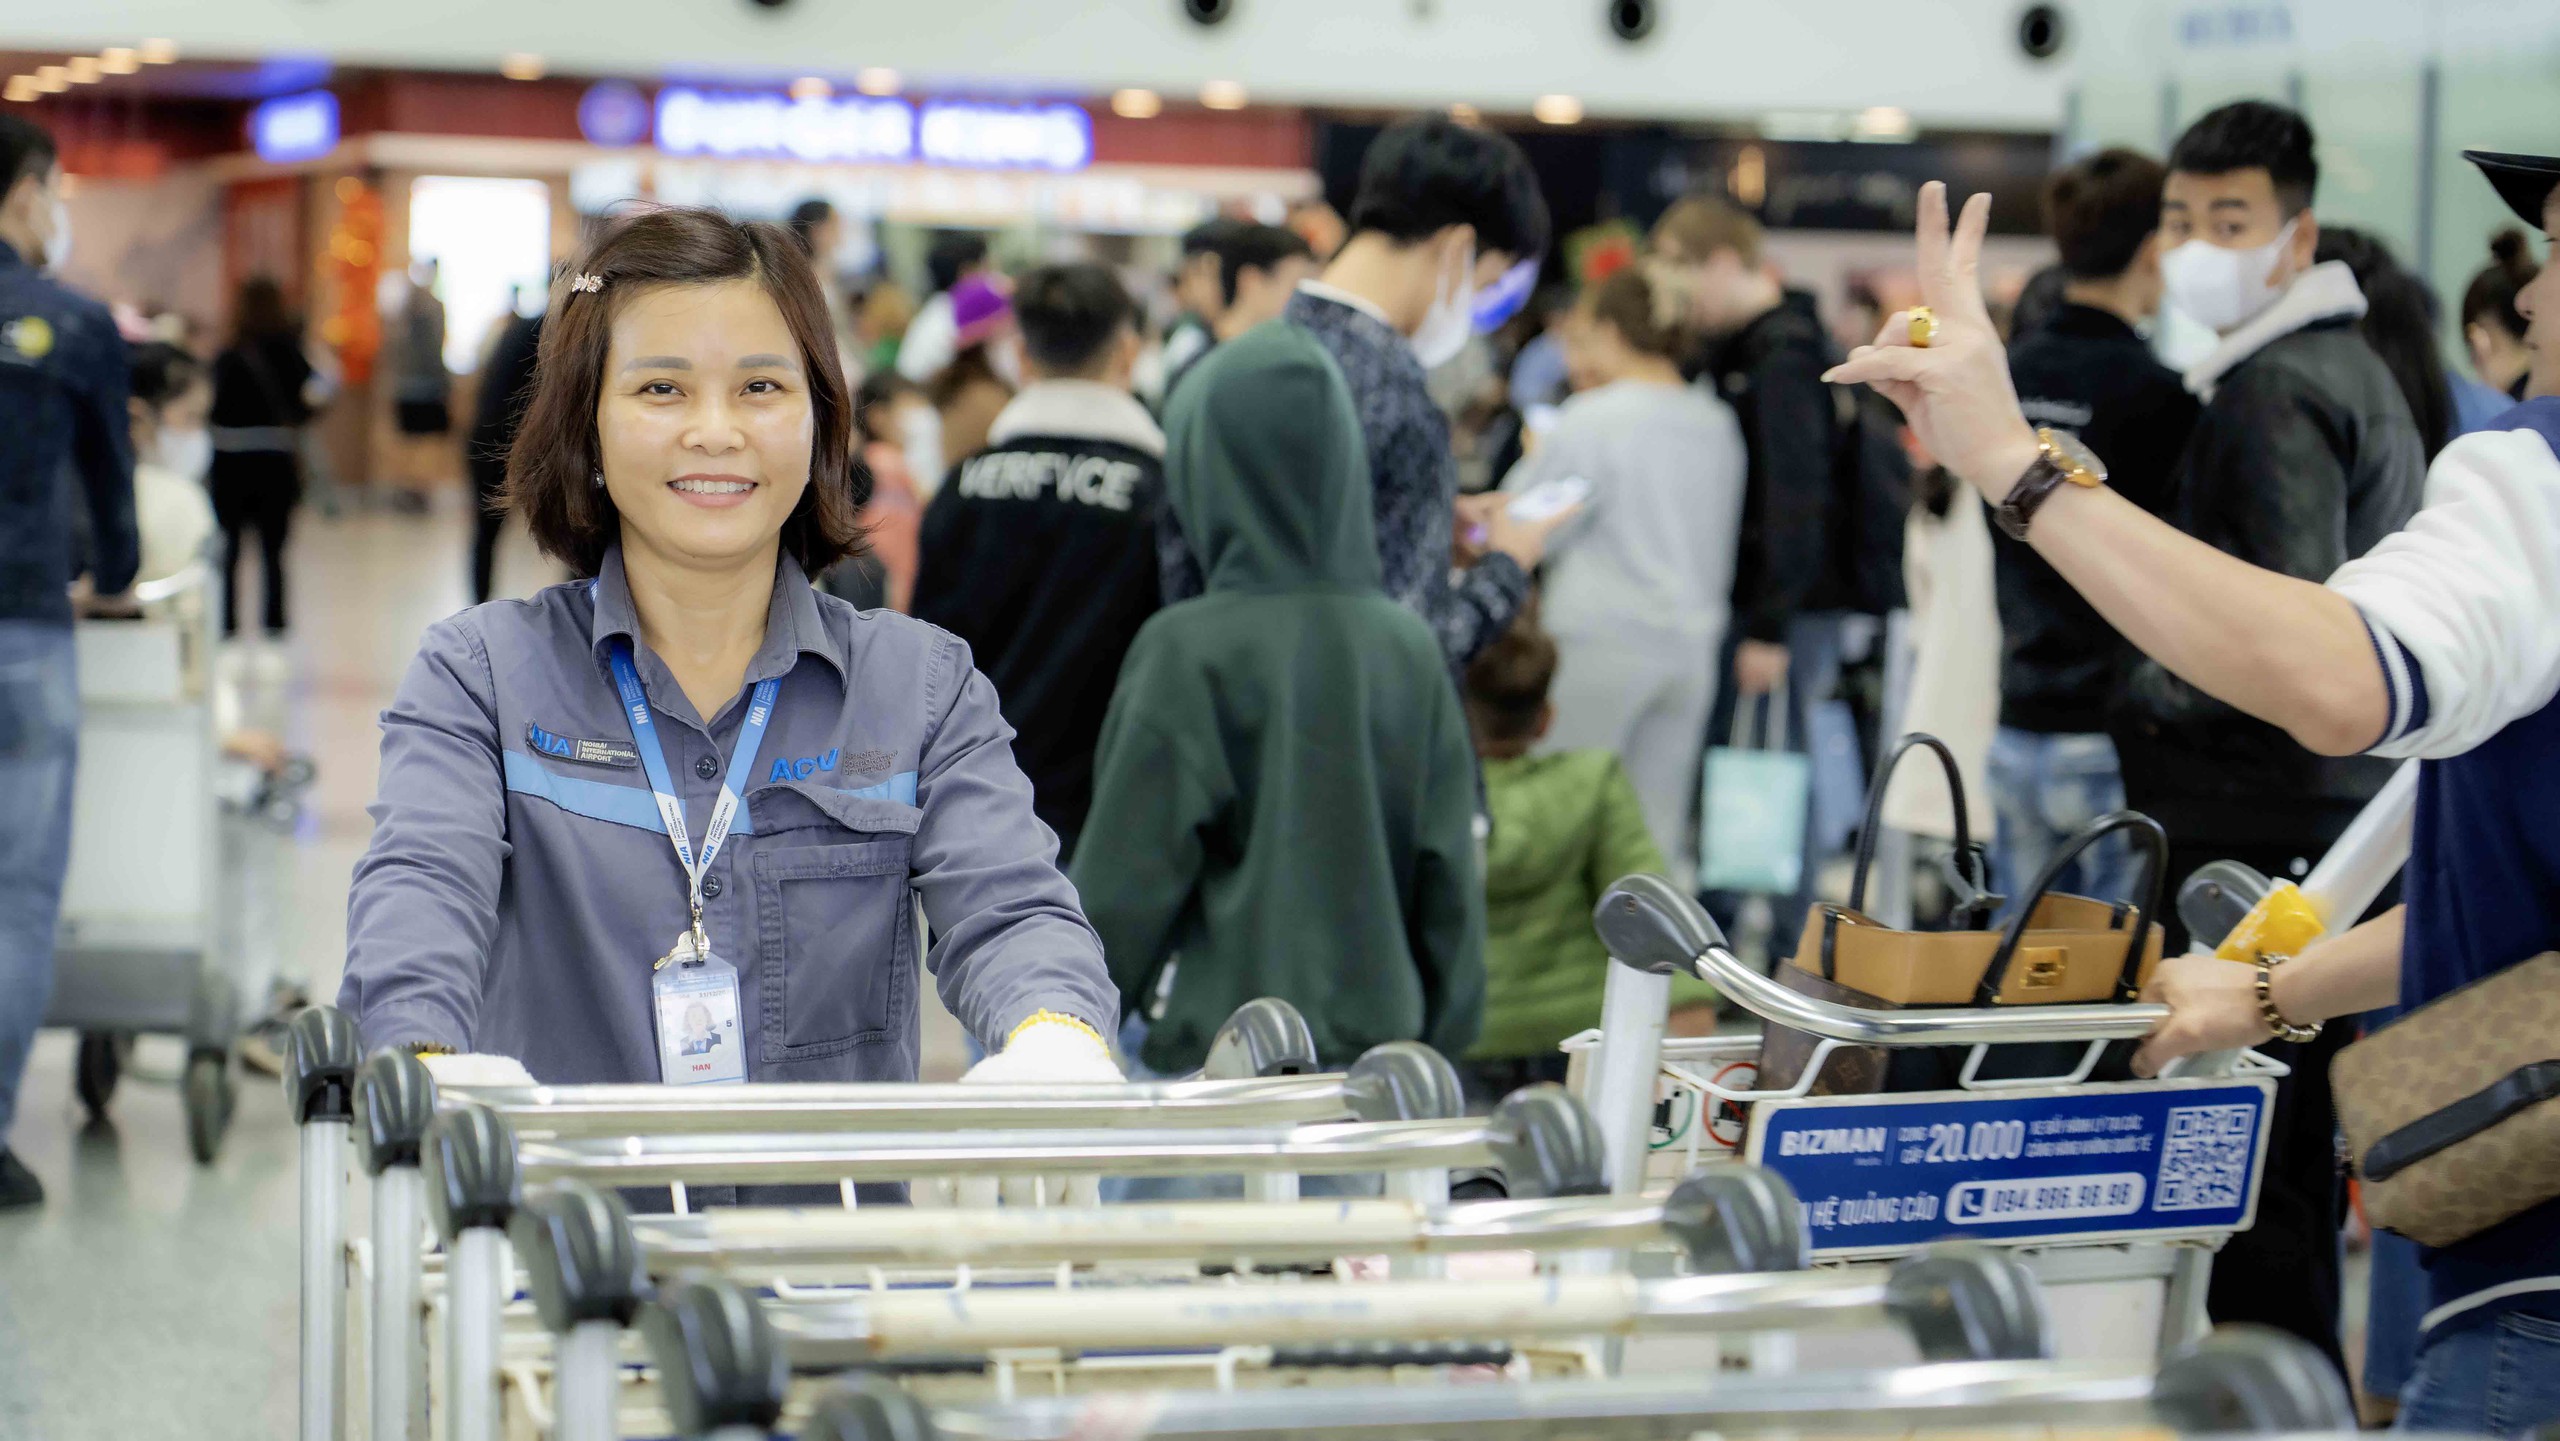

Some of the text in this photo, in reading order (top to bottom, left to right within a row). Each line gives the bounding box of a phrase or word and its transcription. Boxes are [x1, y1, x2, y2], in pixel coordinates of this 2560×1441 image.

[632, 703, 649, 725] NIA
[750, 706, 767, 726] NIA
[531, 722, 572, 757] NIA
[580, 754, 612, 762] AIRPORT
[581, 747, 636, 758] INTERNATIONAL
[769, 747, 839, 783] ACV
[712, 801, 730, 839] INTERNATIONAL
[717, 819, 728, 840] AIRPORT
[680, 845, 692, 865] NIA
[702, 844, 715, 865] NIA
[692, 1063, 711, 1072] HAN
[1779, 1126, 1888, 1156] BIZMAN
[1924, 1119, 2026, 1163] 20.000
[1838, 1190, 1901, 1226] QUẢNG
[1900, 1190, 1939, 1222] CÁO
[1991, 1182, 2133, 1213] 094.986.98.98
